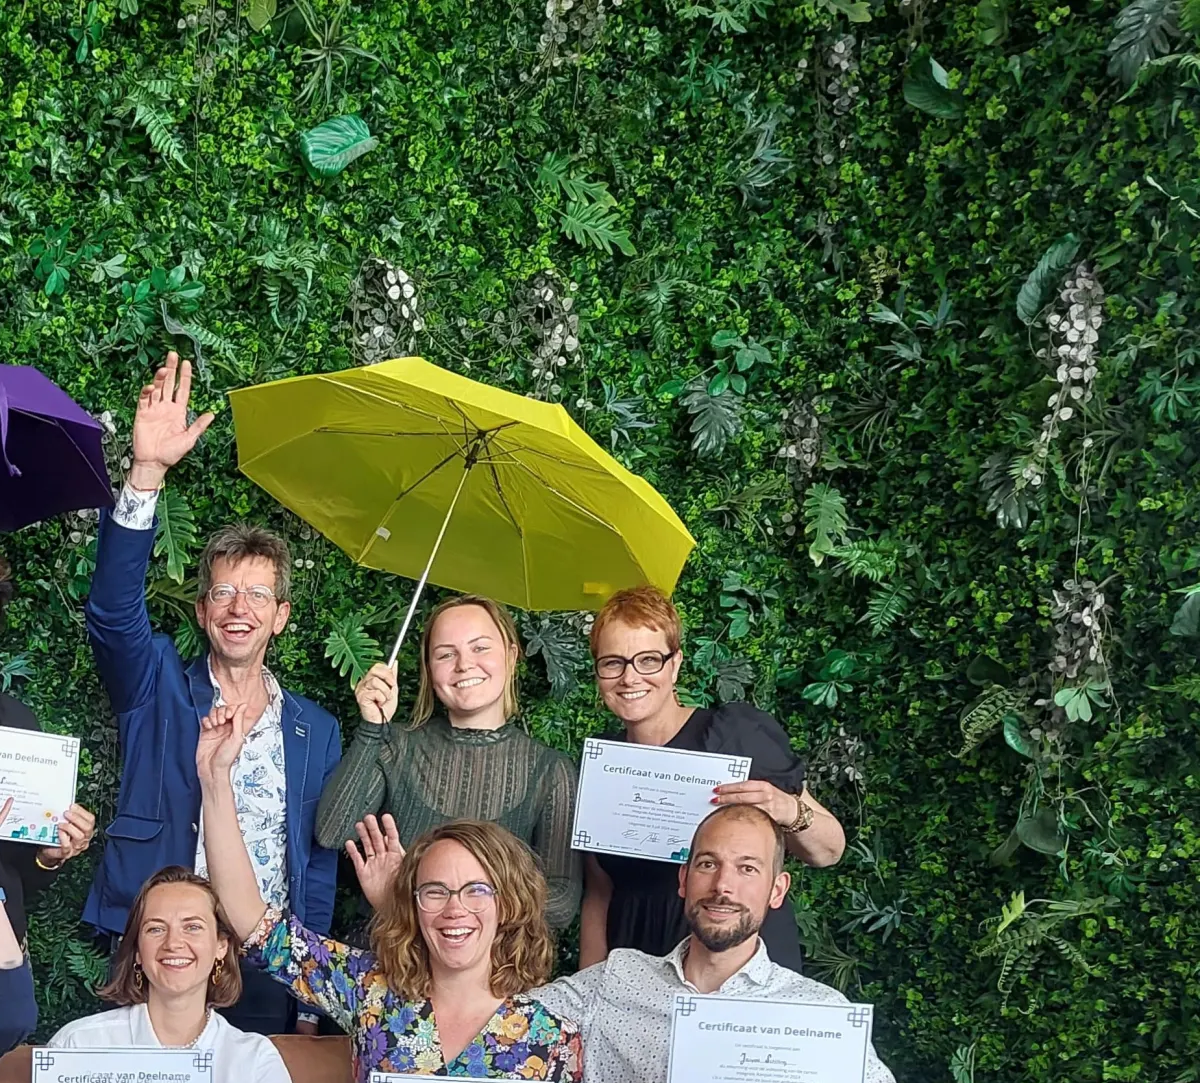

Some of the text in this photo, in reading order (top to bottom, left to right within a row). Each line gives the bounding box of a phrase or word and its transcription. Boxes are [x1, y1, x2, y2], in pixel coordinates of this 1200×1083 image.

[15, 753, 58, 766] Deelname
[603, 765, 652, 778] Certificaat
[674, 773, 722, 786] Deelname
[698, 1021, 842, 1039] Certificaat van Deelname
